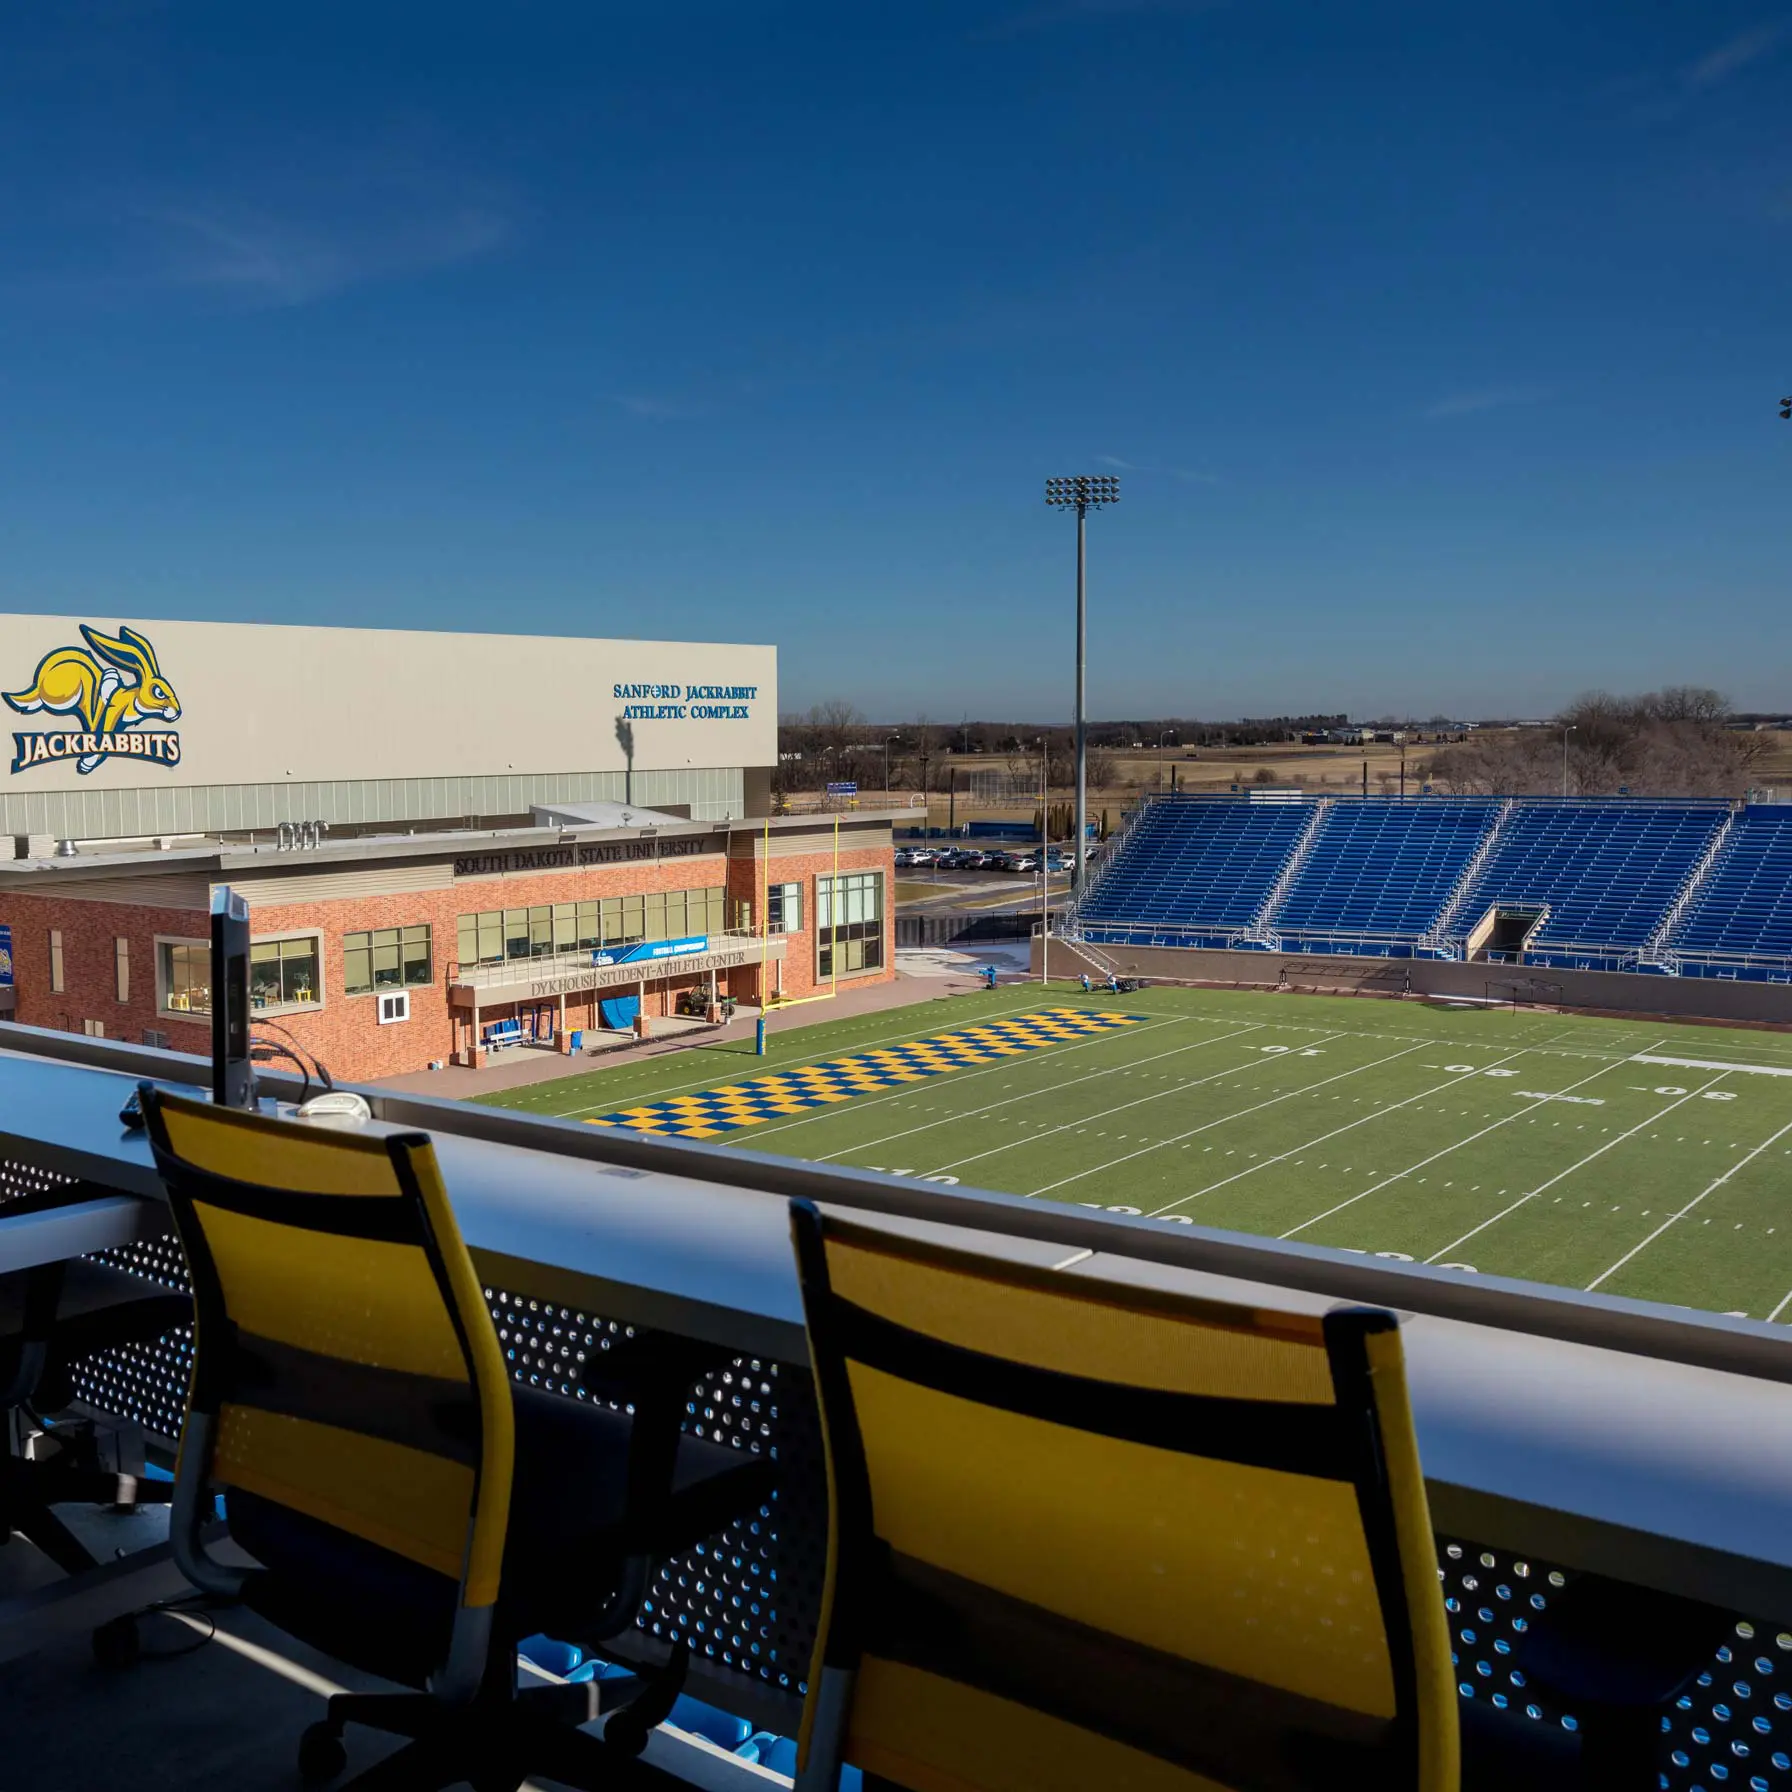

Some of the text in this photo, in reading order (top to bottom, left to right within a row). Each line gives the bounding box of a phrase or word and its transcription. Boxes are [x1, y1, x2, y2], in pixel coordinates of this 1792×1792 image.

[613, 684, 758, 702] SANFORD JACKRABBIT
[622, 705, 749, 719] ATHLETIC COMPLEX
[19, 733, 179, 767] JACKRABBITS
[455, 839, 704, 874] SOUTH DAKOTA STATE UNIVERSITY
[531, 973, 597, 996] DYKHOUSE
[599, 957, 705, 985] STUDENT-ATHLETE
[706, 951, 745, 969] CENTER
